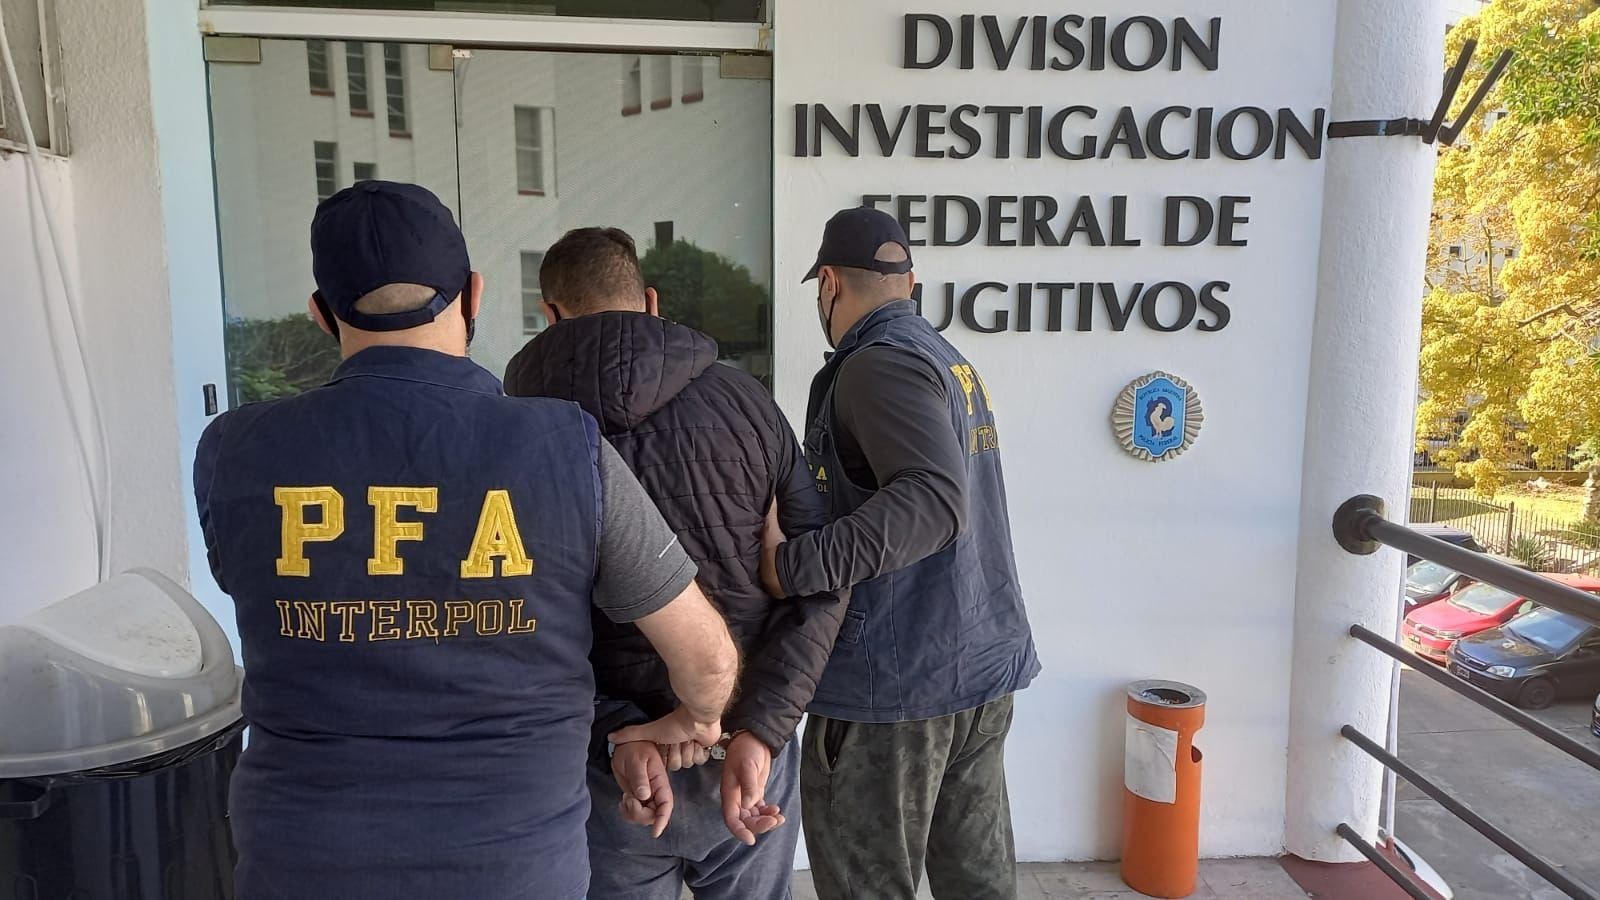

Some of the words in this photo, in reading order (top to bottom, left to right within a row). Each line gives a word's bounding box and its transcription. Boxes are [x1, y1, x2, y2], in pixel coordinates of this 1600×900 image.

[903, 13, 1222, 72] DIVISION
[793, 103, 1326, 161] INVESTIGACION
[1163, 195, 1251, 247] DE
[911, 280, 1232, 334] UGITIVOS
[275, 599, 537, 643] INTERPOL
